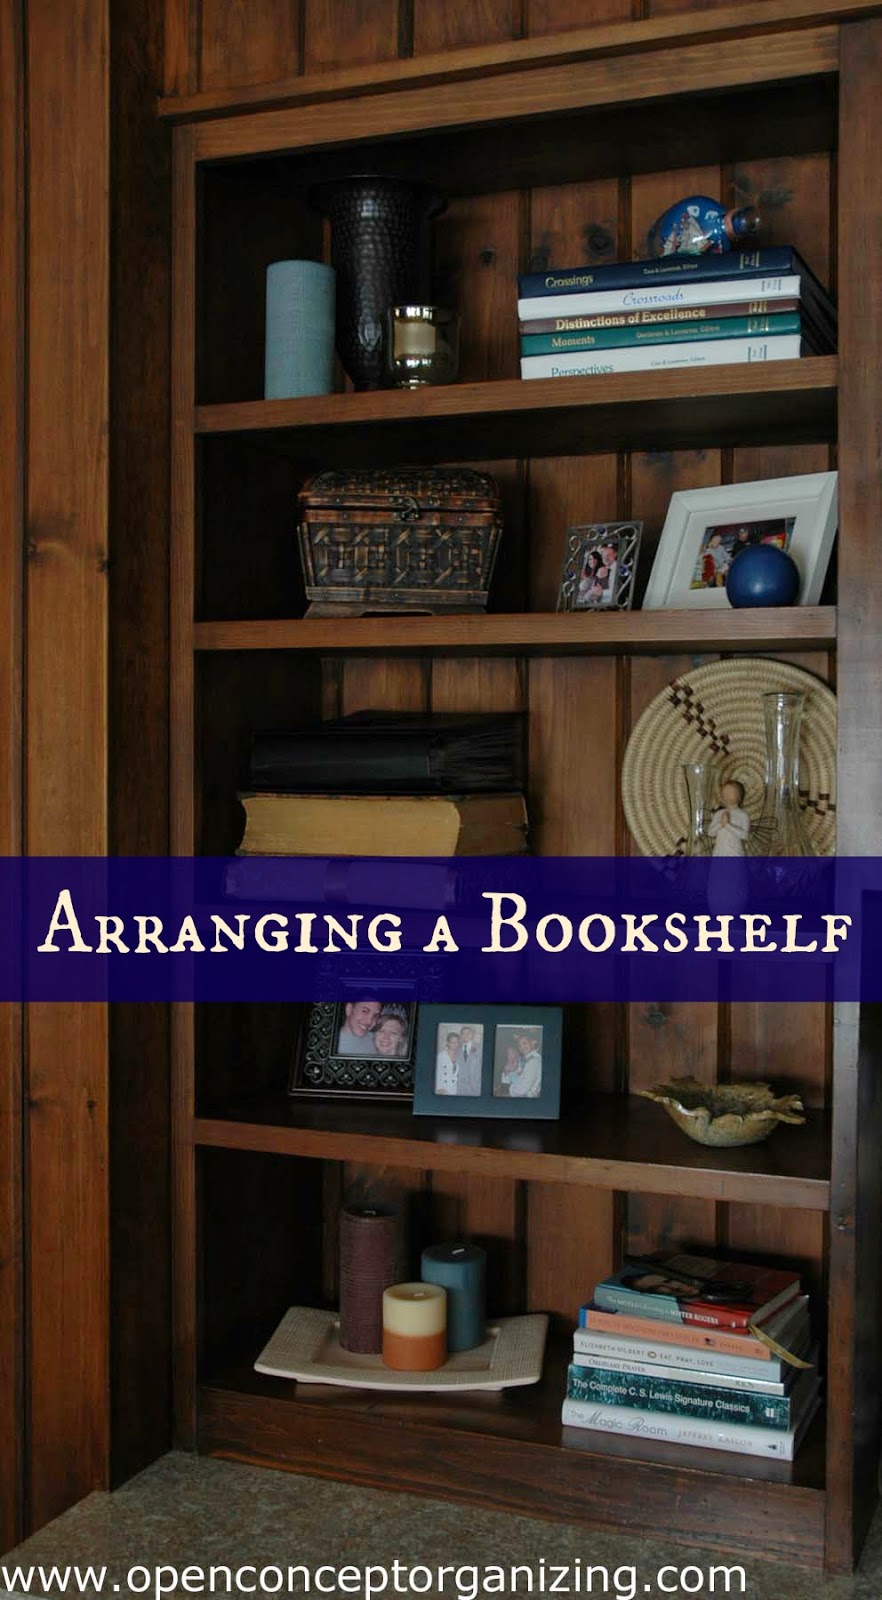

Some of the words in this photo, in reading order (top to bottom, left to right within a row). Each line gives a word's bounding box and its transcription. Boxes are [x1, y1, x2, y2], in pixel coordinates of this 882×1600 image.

[545, 274, 594, 288] Crossings
[622, 288, 684, 306] Crossroads
[556, 315, 625, 331] Distinctions
[628, 313, 640, 324] of
[642, 308, 706, 323] Excellence
[552, 335, 596, 348] Moments
[551, 363, 614, 377] Perspectives
[573, 1378, 588, 1388] The
[589, 1380, 628, 1395] Complete
[628, 1386, 638, 1396] C.
[649, 1390, 673, 1402] Lewis
[674, 1393, 714, 1408] Signature
[715, 1400, 751, 1413] Classics
[583, 1409, 622, 1429] Magic
[626, 1416, 668, 1437] Room
